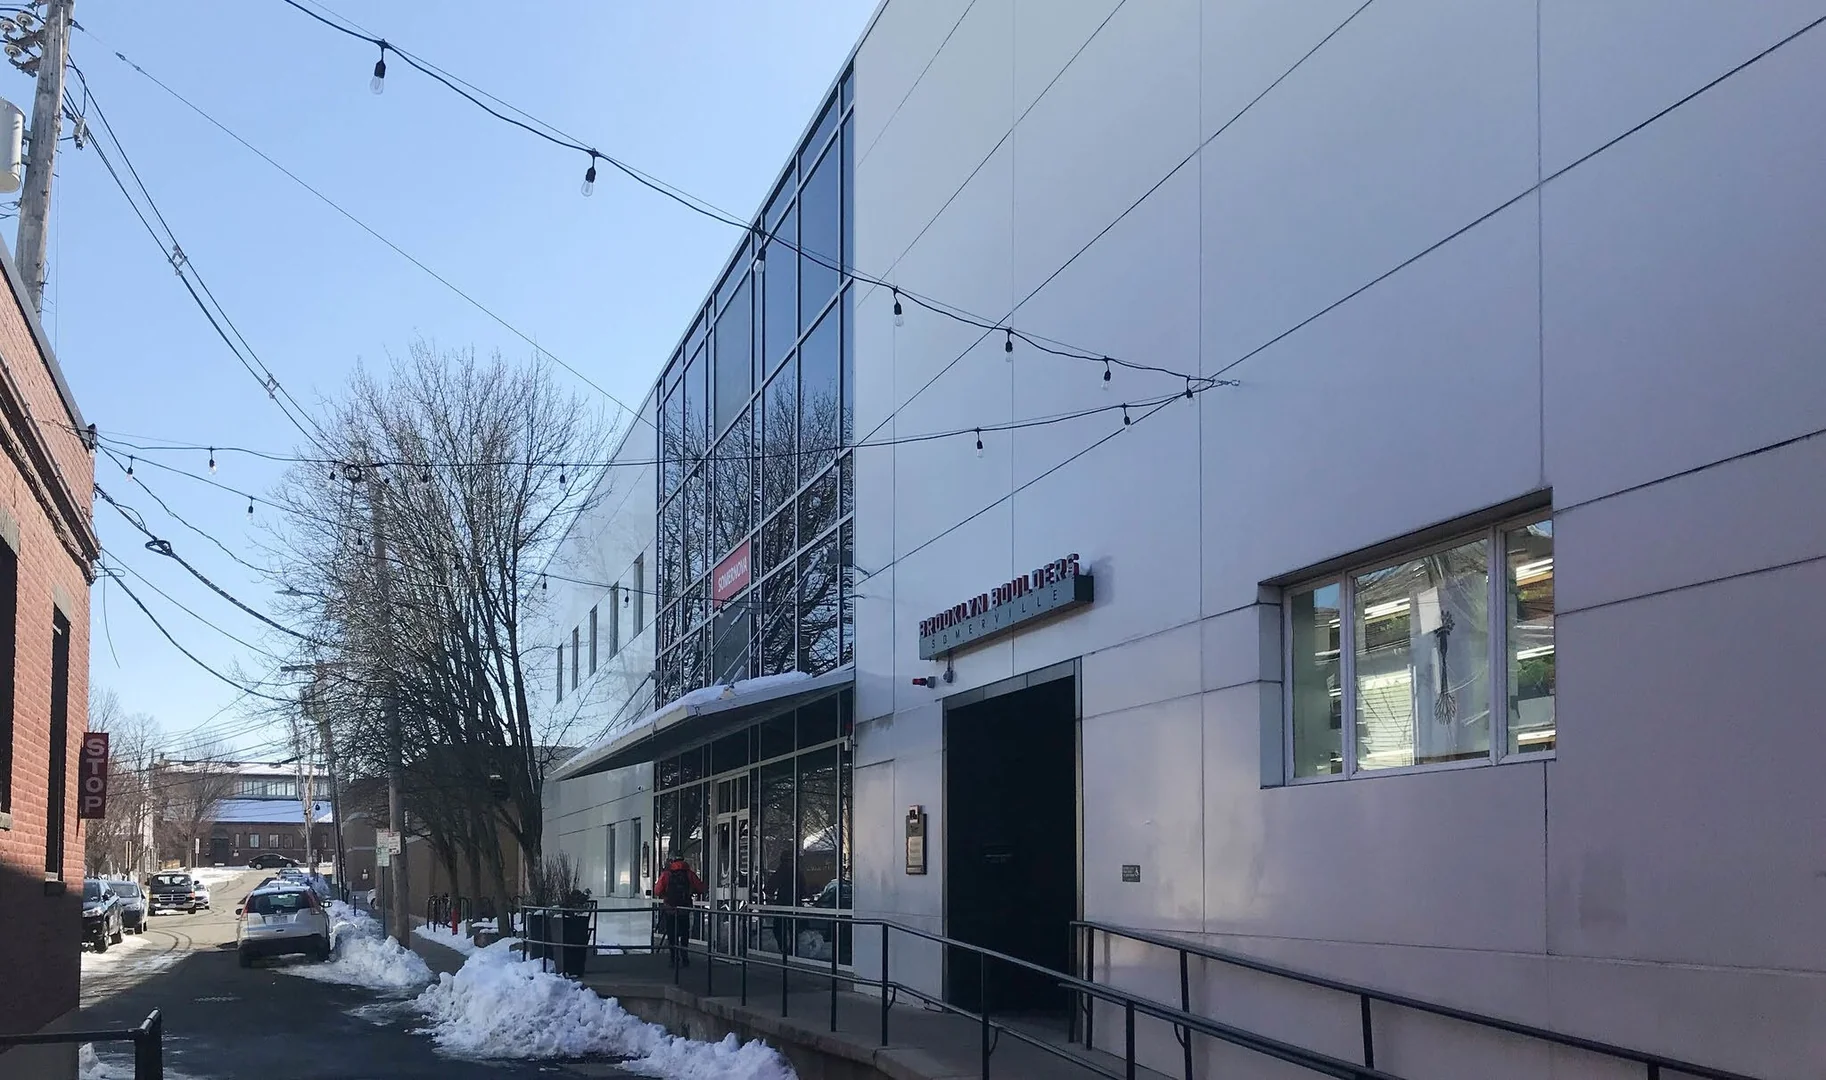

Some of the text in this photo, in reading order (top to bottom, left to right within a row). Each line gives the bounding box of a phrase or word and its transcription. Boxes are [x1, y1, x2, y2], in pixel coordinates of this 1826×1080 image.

[919, 553, 1080, 637] BROOKLYN BOULDERS
[931, 589, 1059, 649] SOMERVILLE
[84, 738, 106, 814] STOP
